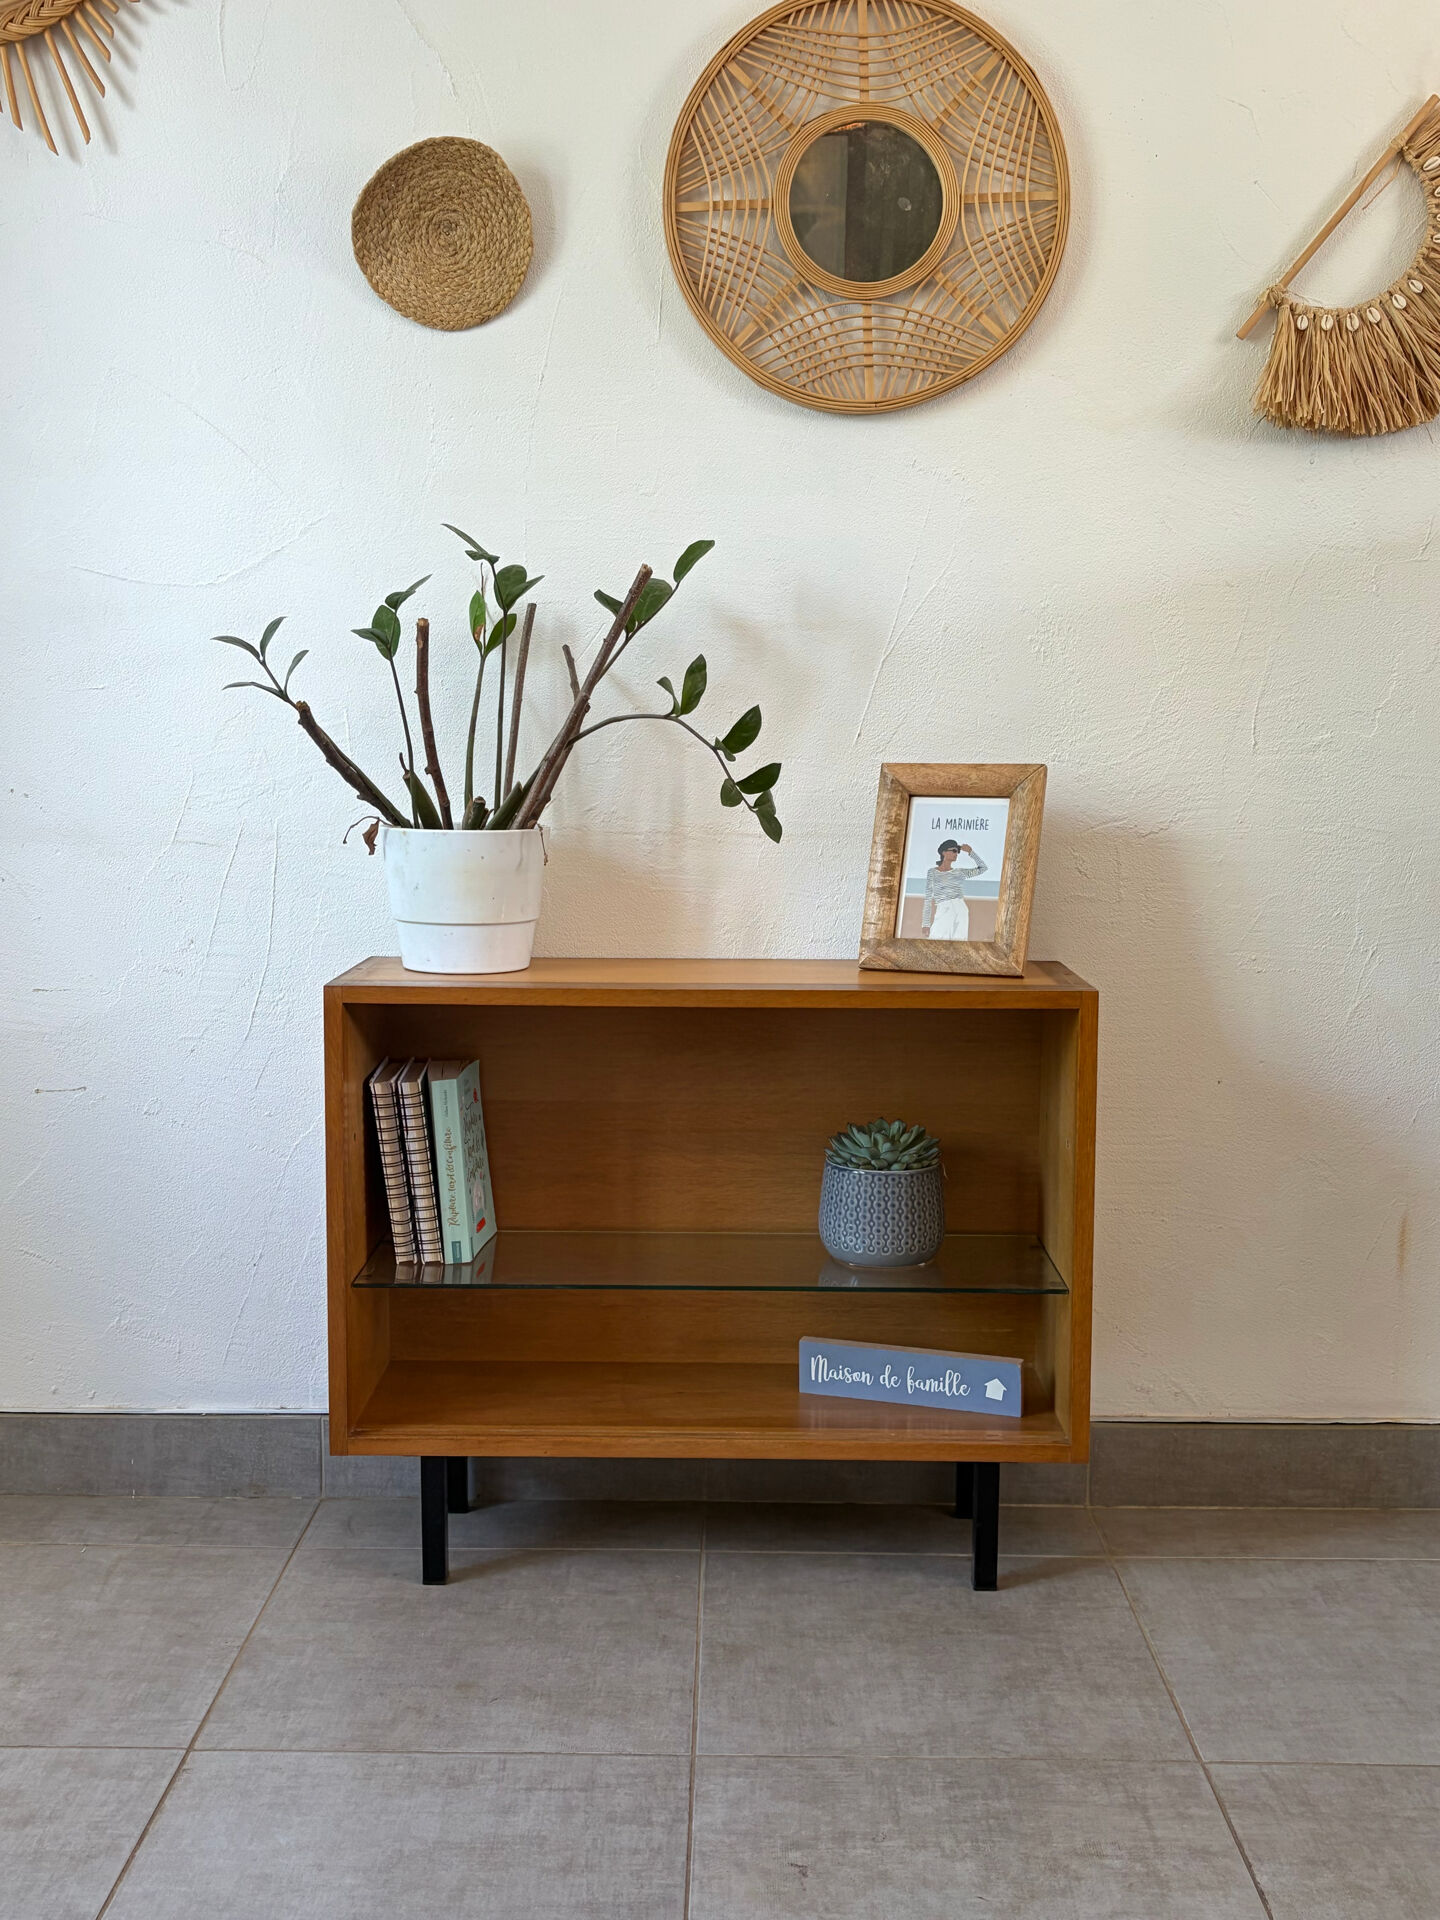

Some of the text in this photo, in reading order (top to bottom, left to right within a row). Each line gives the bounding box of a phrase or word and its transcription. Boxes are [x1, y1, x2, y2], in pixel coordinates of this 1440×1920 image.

[931, 816, 990, 831] LA MARINIÈRE
[810, 1355, 971, 1397] Maison de famille
